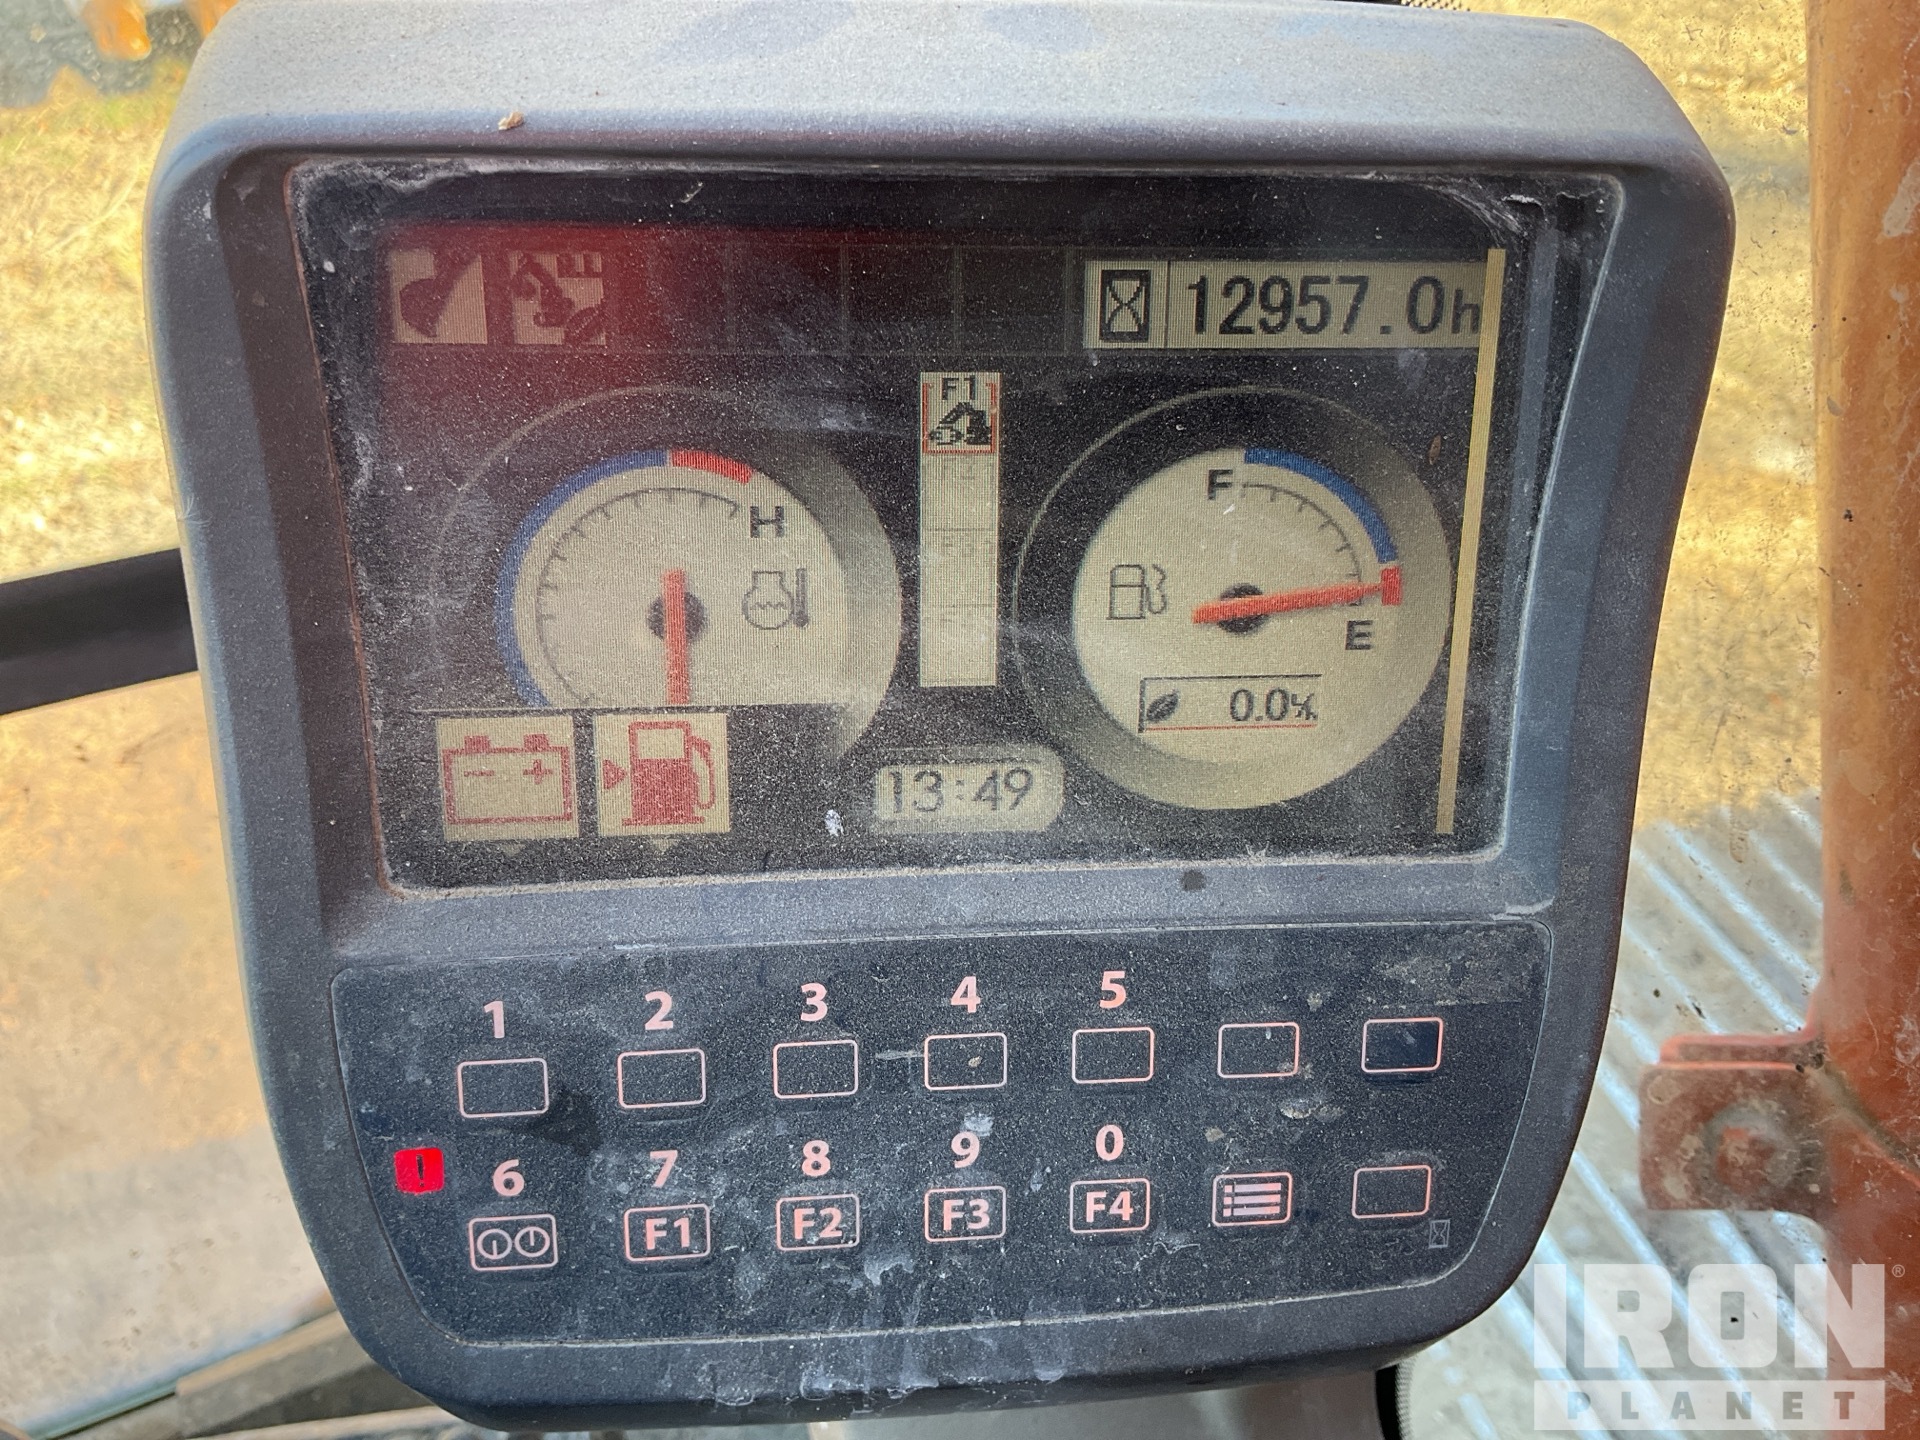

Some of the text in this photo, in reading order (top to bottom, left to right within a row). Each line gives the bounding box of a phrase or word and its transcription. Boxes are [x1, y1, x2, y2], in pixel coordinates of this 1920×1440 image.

[1187, 274, 1481, 335] 12957.0h
[941, 375, 977, 400] F1
[1207, 469, 1233, 500] F
[750, 505, 785, 538] H
[1345, 620, 1373, 650] E
[1229, 688, 1318, 722] 0.0%
[888, 767, 1034, 813] 13:49
[800, 983, 828, 1022] 3
[950, 976, 981, 1013] 4
[1099, 970, 1127, 1009] 5
[484, 1000, 505, 1038] 1
[645, 991, 674, 1030] 2
[801, 1140, 831, 1176] 8
[951, 1131, 980, 1168] 9
[1095, 1124, 1124, 1161] 0
[493, 1159, 525, 1196] 6
[649, 1150, 678, 1188] 7
[793, 1207, 843, 1240] F2
[942, 1198, 990, 1231] F3
[1085, 1190, 1133, 1223] F4
[645, 1217, 690, 1250] F1
